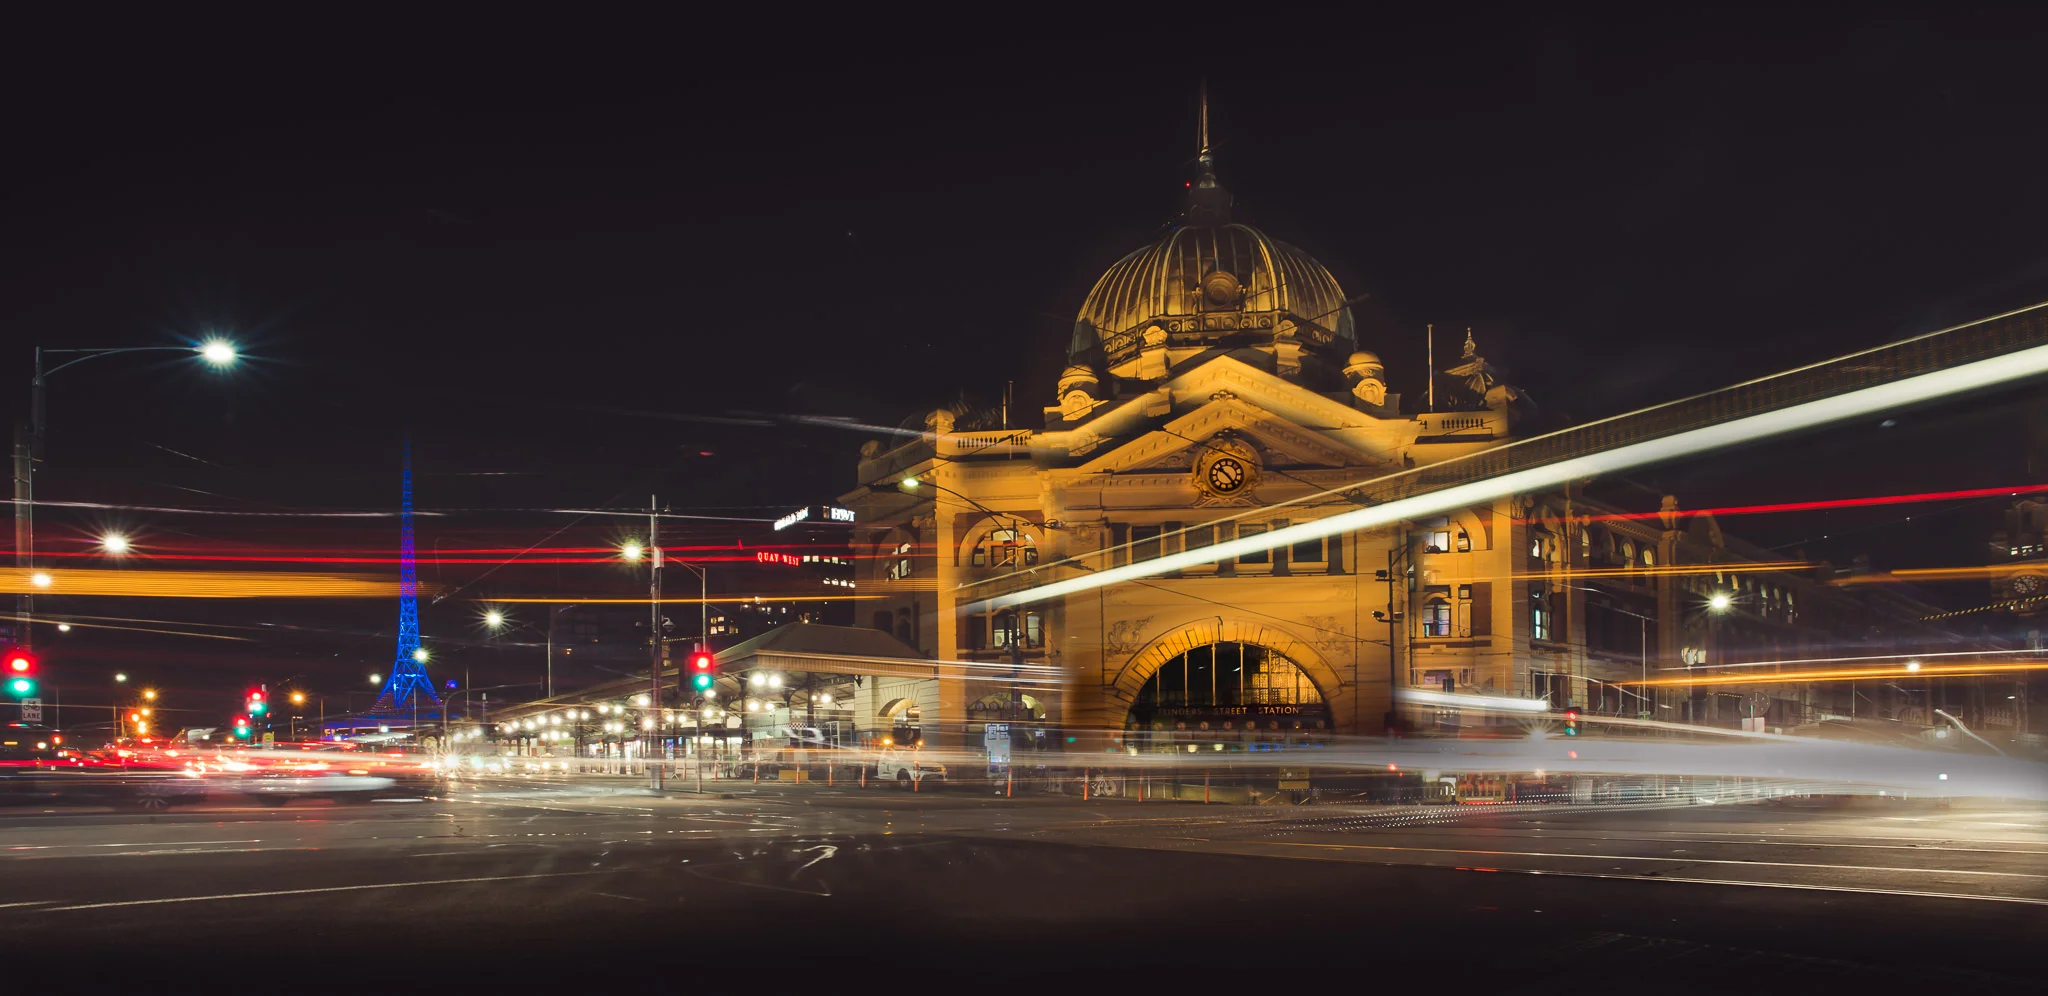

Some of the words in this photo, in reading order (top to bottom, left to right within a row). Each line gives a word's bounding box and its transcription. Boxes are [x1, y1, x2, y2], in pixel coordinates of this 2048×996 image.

[757, 552, 779, 562] QUAY
[1158, 708, 1202, 716] FLINDERS
[1213, 707, 1248, 715] STREET
[1257, 706, 1300, 715] STATION
